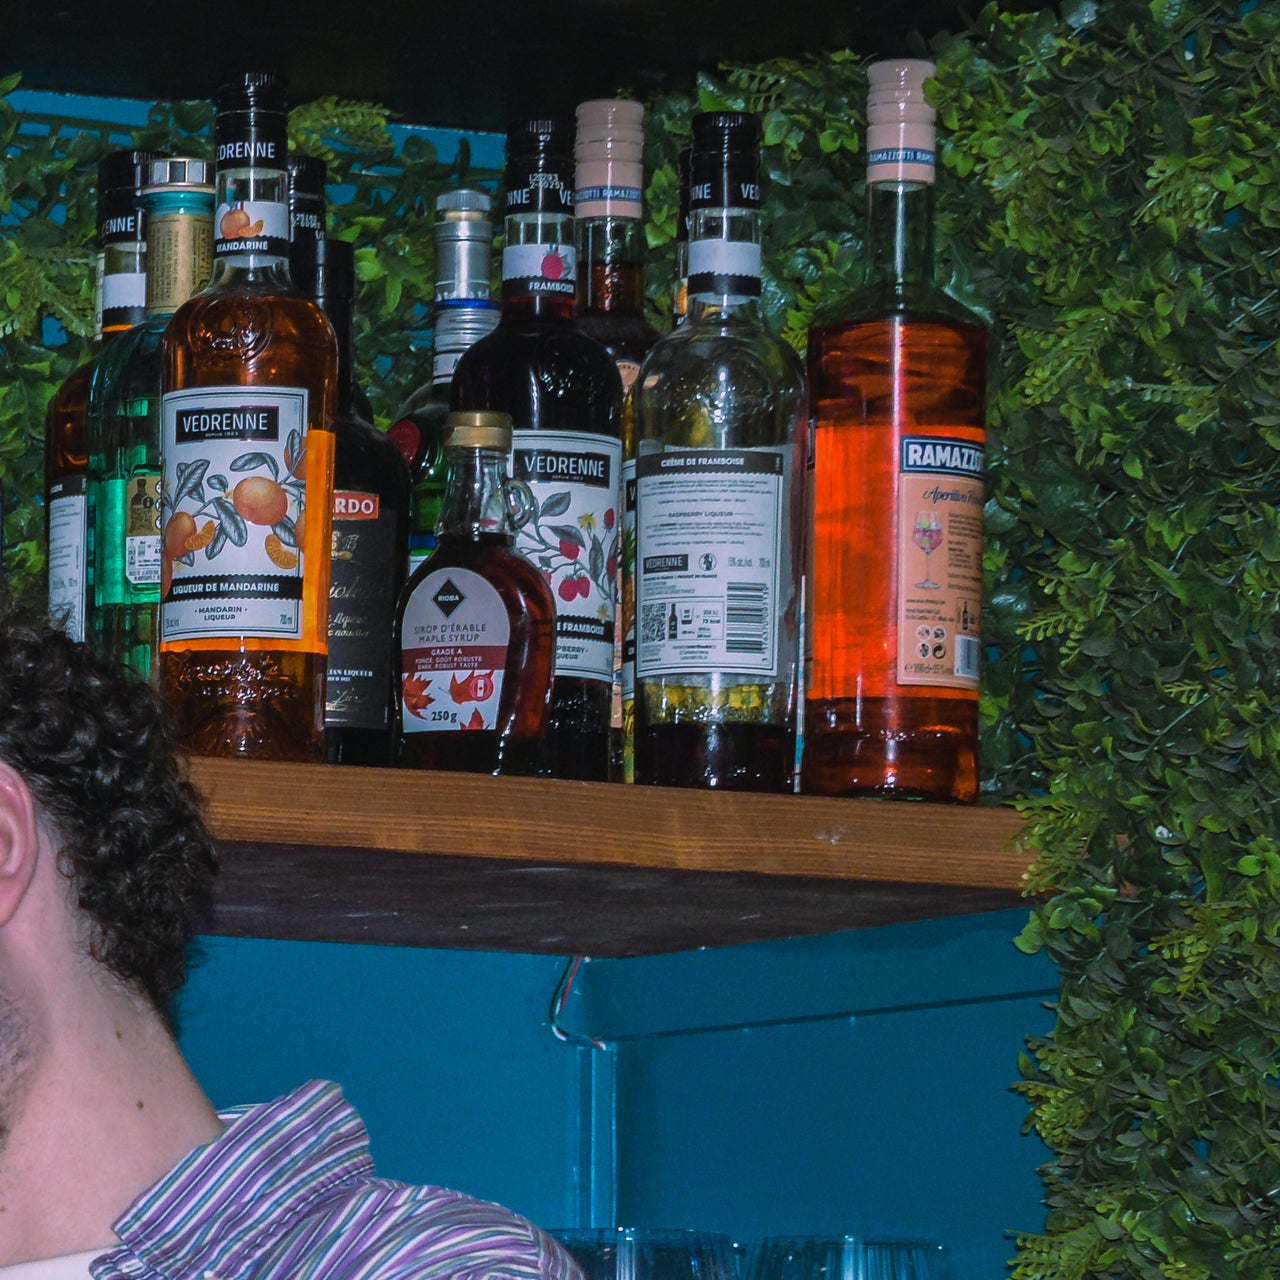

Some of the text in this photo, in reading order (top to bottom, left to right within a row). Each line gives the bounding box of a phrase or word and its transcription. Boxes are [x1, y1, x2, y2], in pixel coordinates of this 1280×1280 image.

[182, 413, 268, 433] VEDRENNE
[524, 455, 604, 479] VEDRENNE
[661, 457, 745, 468] CRÈME DE FRAMBOISE
[173, 582, 280, 595] LIQUEUR DE MANDARINE
[199, 606, 242, 614] MANDARIN
[414, 623, 487, 635] SIROP D'ÉRABLE
[418, 634, 480, 643] MAPLE SYRUP
[431, 711, 457, 723] 250 g
